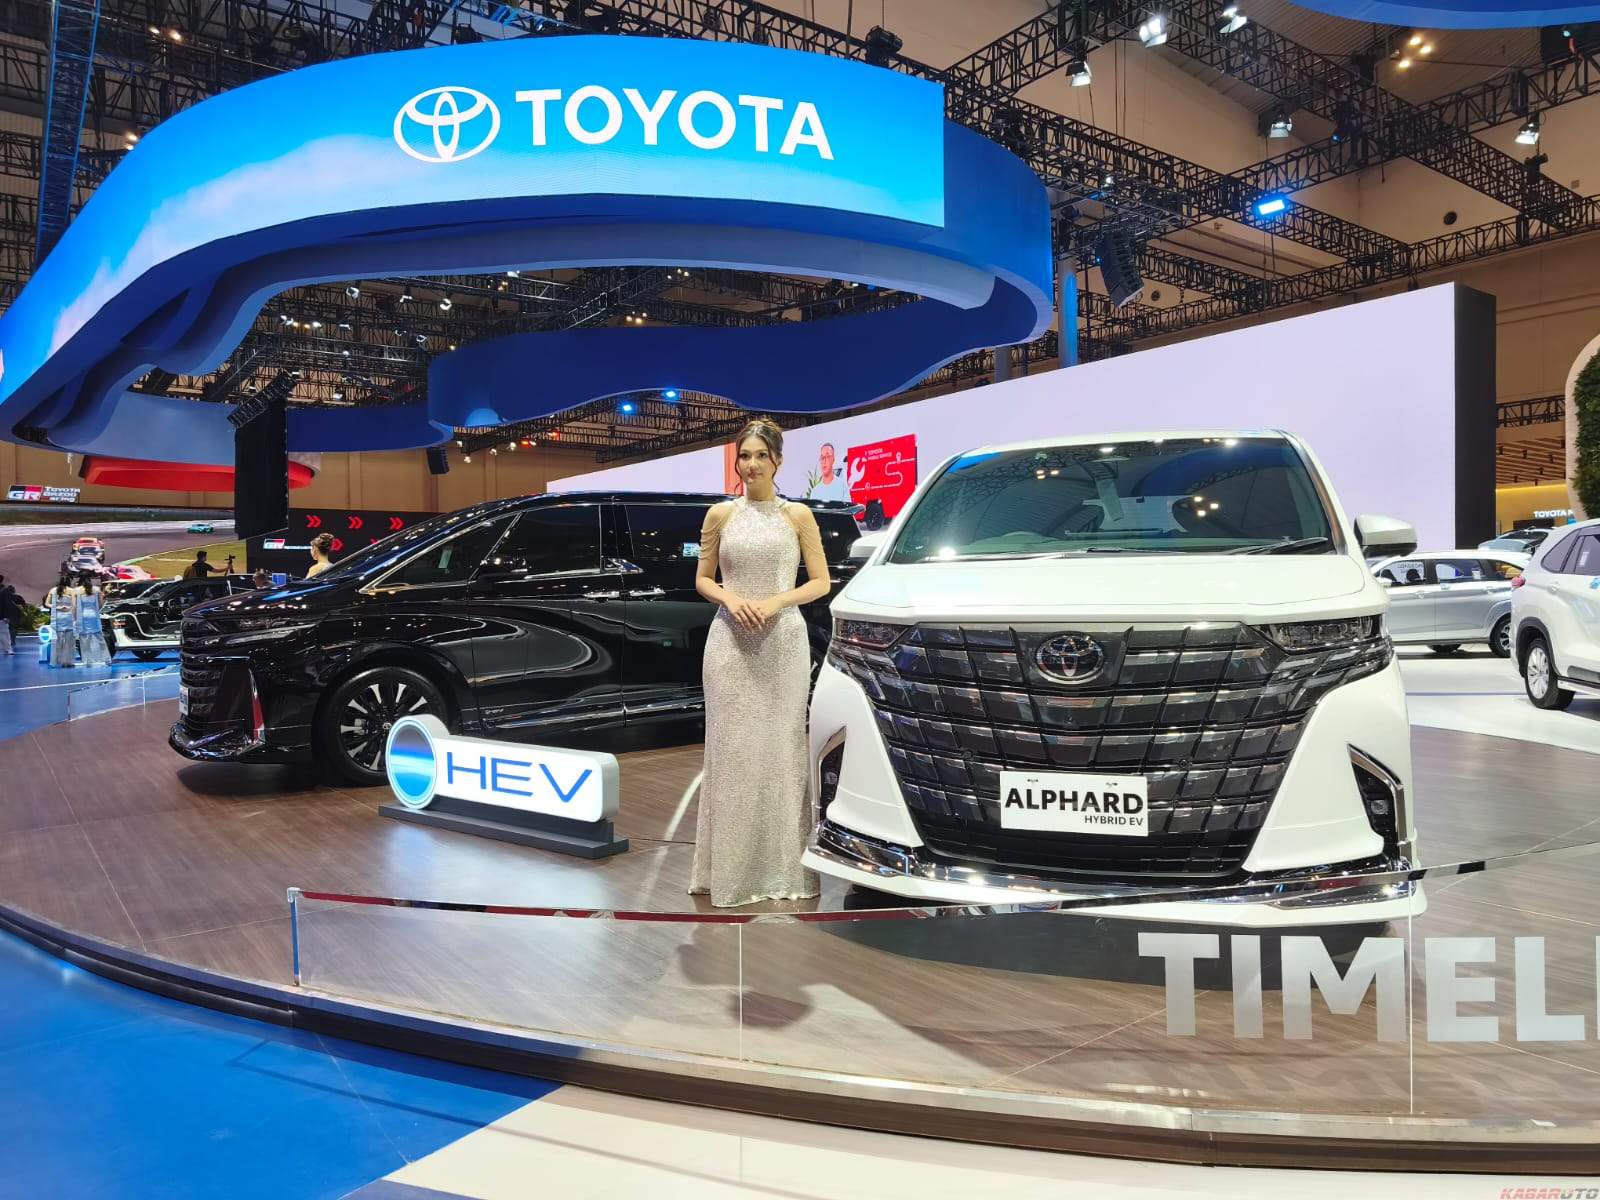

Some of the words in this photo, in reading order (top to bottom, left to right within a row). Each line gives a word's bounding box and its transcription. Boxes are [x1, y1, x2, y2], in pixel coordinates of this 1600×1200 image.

[515, 85, 835, 160] TOYOTA
[8, 490, 41, 500] GR
[1533, 509, 1567, 518] TOYOTA
[446, 751, 593, 803] HEV
[1004, 787, 1144, 815] ALPHARD
[1084, 815, 1127, 825] HYBRID
[1129, 817, 1144, 826] EV
[1138, 931, 1600, 1043] TIMEL
